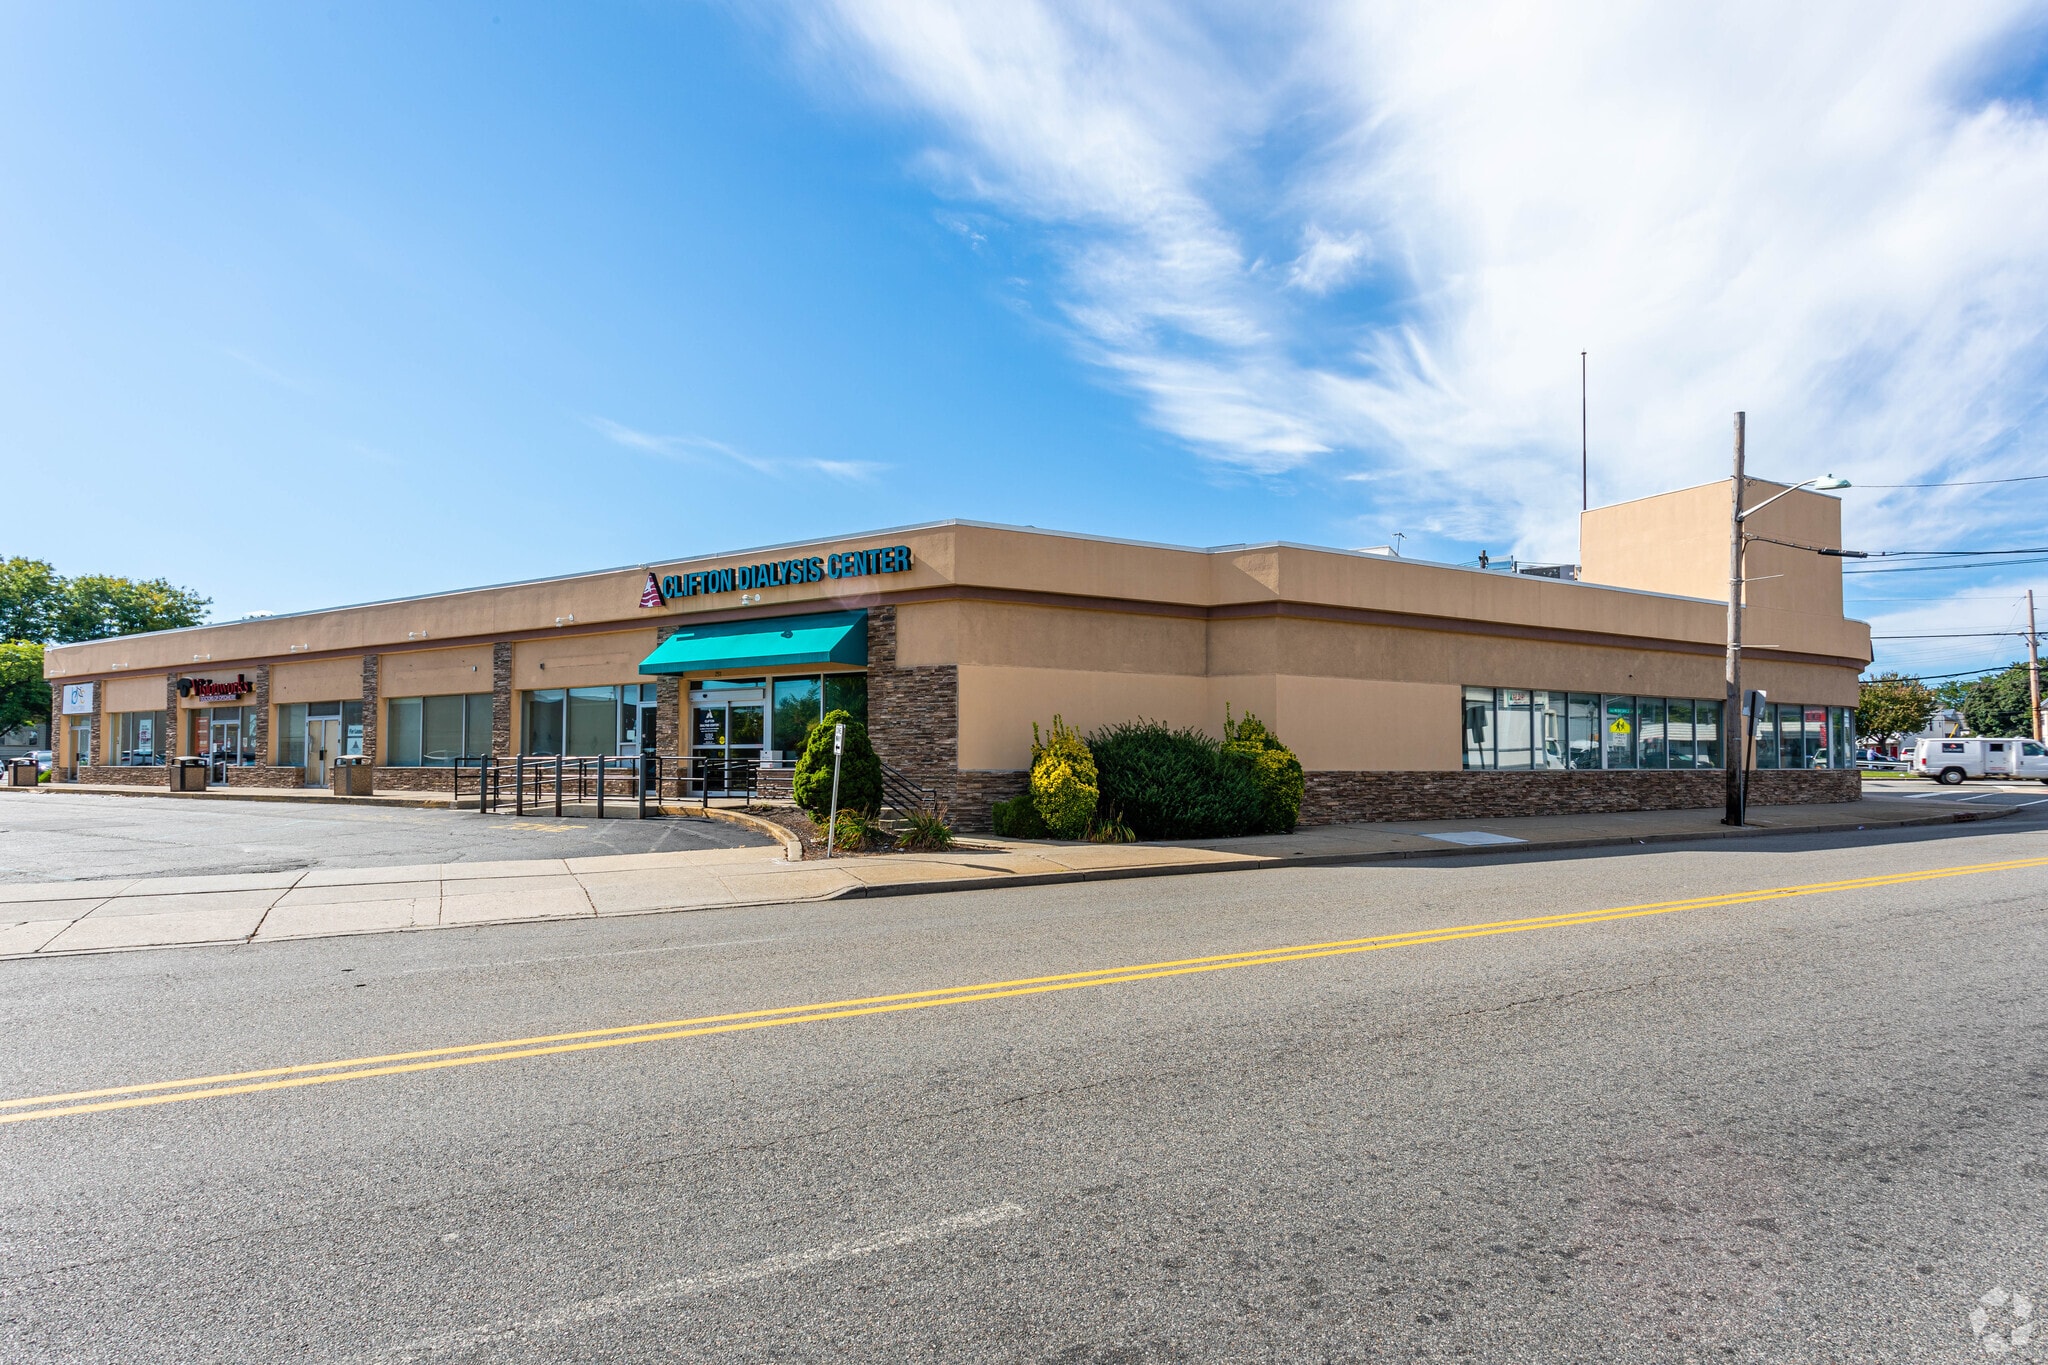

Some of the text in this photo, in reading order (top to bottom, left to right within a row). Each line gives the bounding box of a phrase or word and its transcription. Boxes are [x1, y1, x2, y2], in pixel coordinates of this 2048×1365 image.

[662, 545, 912, 599] CLIFTON DIALYSIS CENTER
[191, 674, 251, 696] Visionworks
